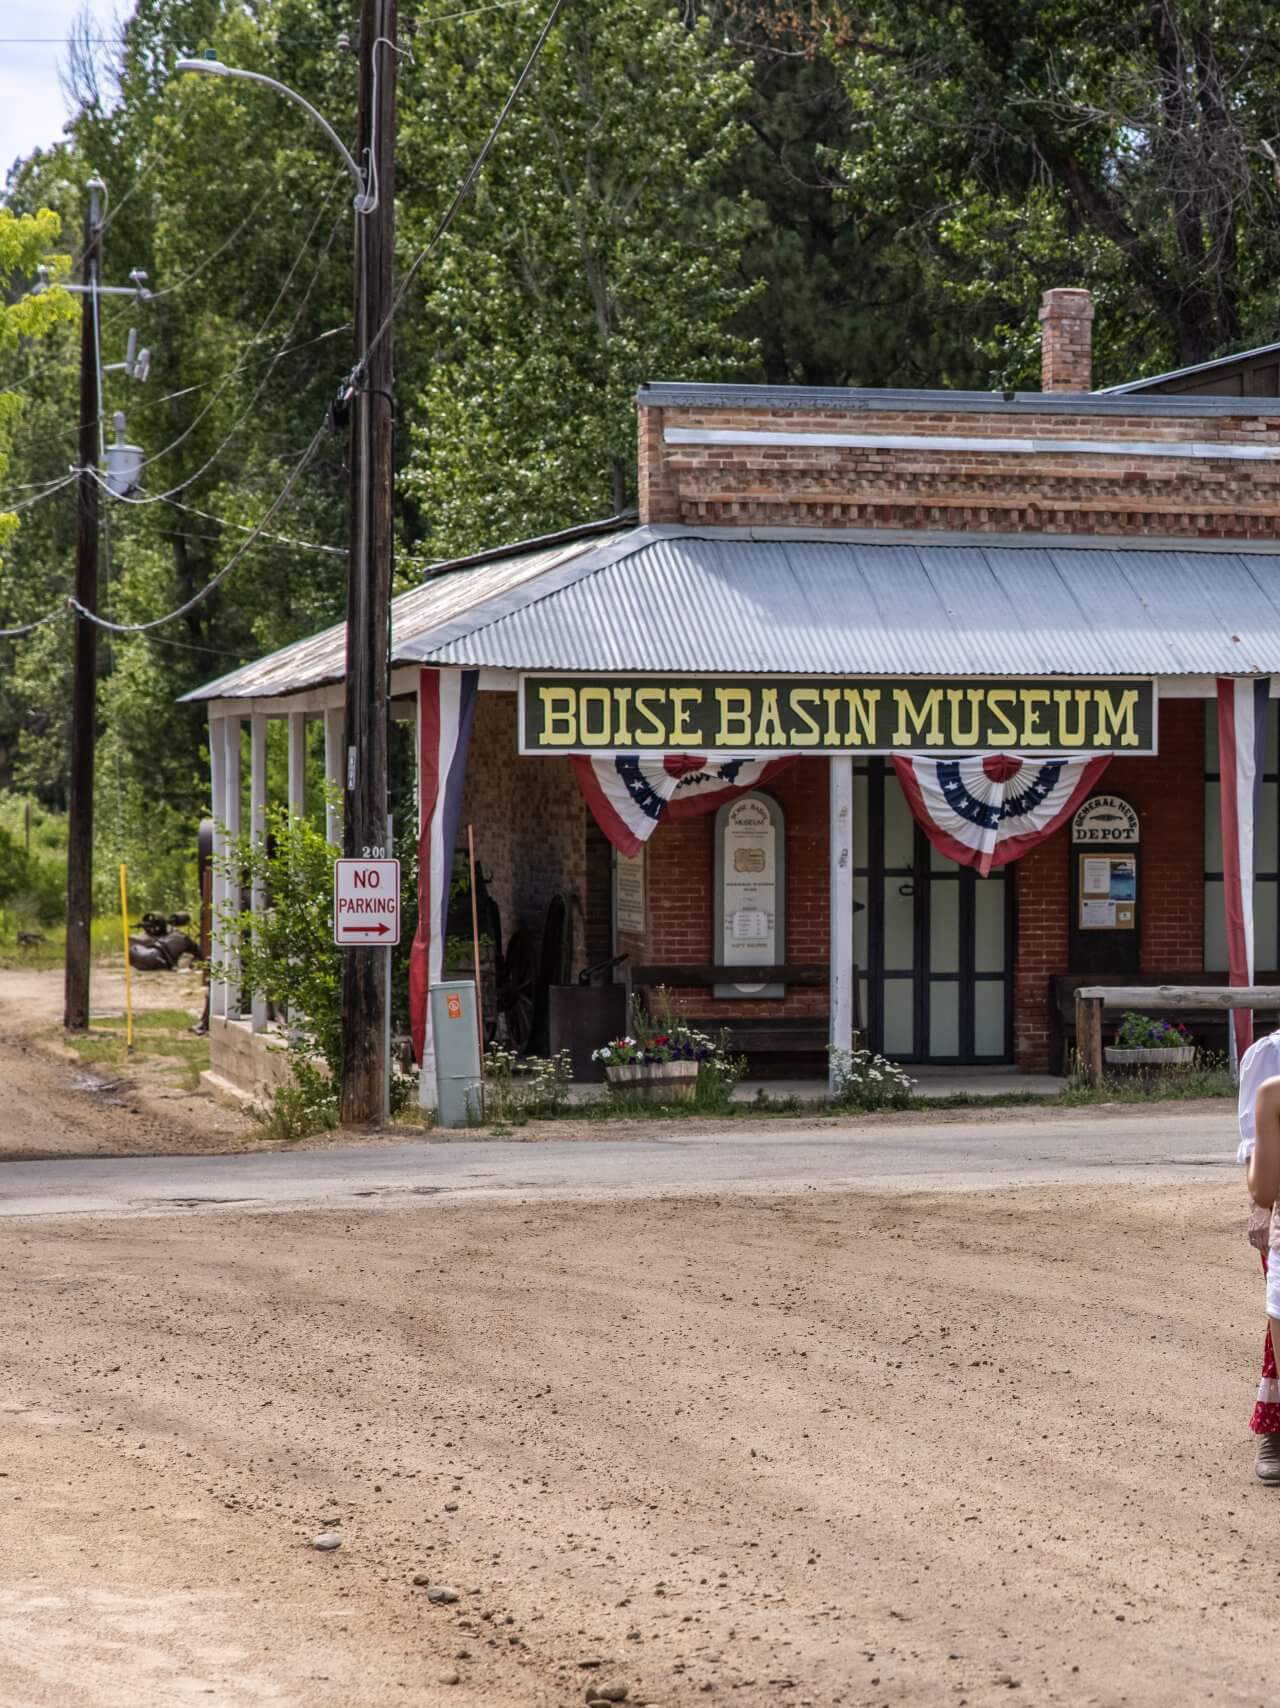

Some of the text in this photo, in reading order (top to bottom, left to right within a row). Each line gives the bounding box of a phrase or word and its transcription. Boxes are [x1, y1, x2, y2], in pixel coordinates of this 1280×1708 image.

[538, 686, 1140, 747] BOISE BASIN MUSEUM
[734, 818, 764, 826] MUSEUM
[1075, 797, 1137, 830] GENERAL NEWS
[1075, 828, 1135, 840] DEPOT
[362, 846, 385, 858] 200
[354, 870, 381, 889] NO
[339, 897, 395, 914] PARKING
